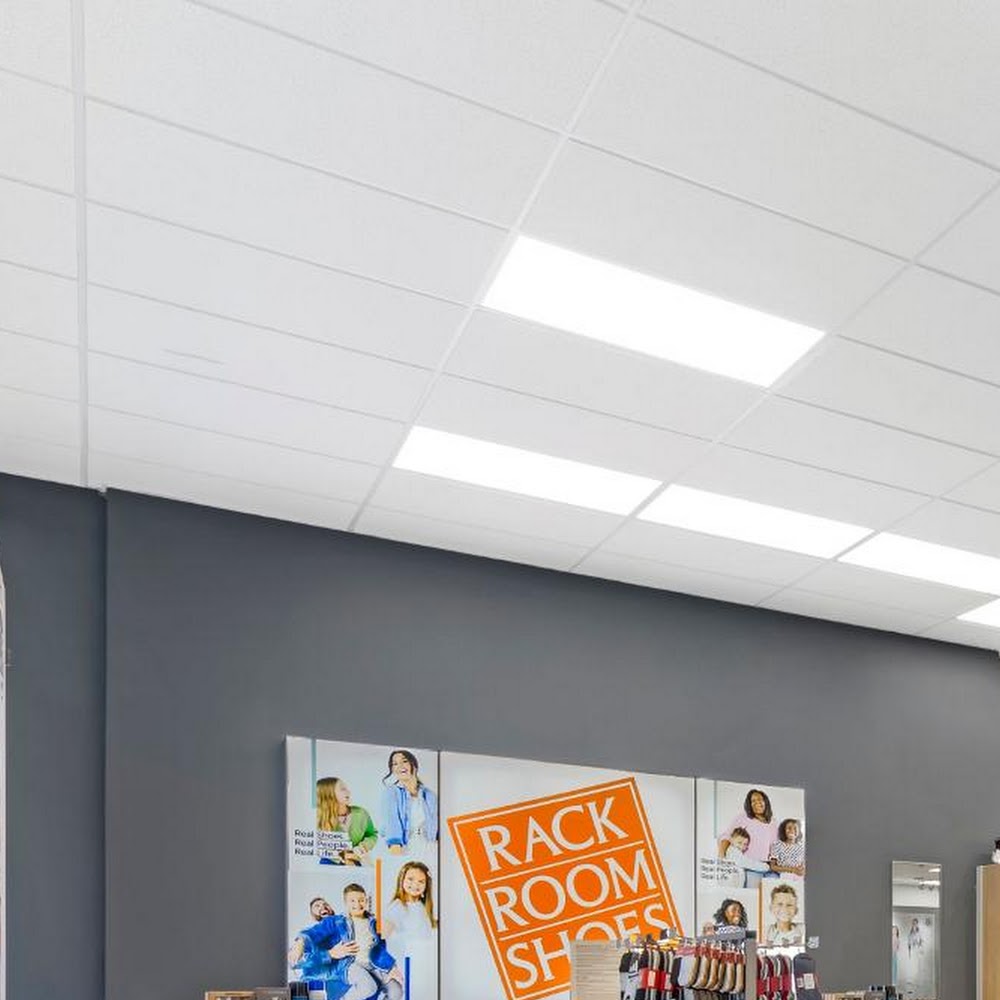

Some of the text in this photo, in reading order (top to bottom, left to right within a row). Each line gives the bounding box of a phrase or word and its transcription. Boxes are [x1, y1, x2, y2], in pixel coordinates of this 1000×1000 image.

[294, 829, 314, 838] Real
[476, 796, 629, 872] RACK
[294, 839, 314, 847] Real
[294, 848, 314, 856] Real
[484, 848, 657, 933] ROOM
